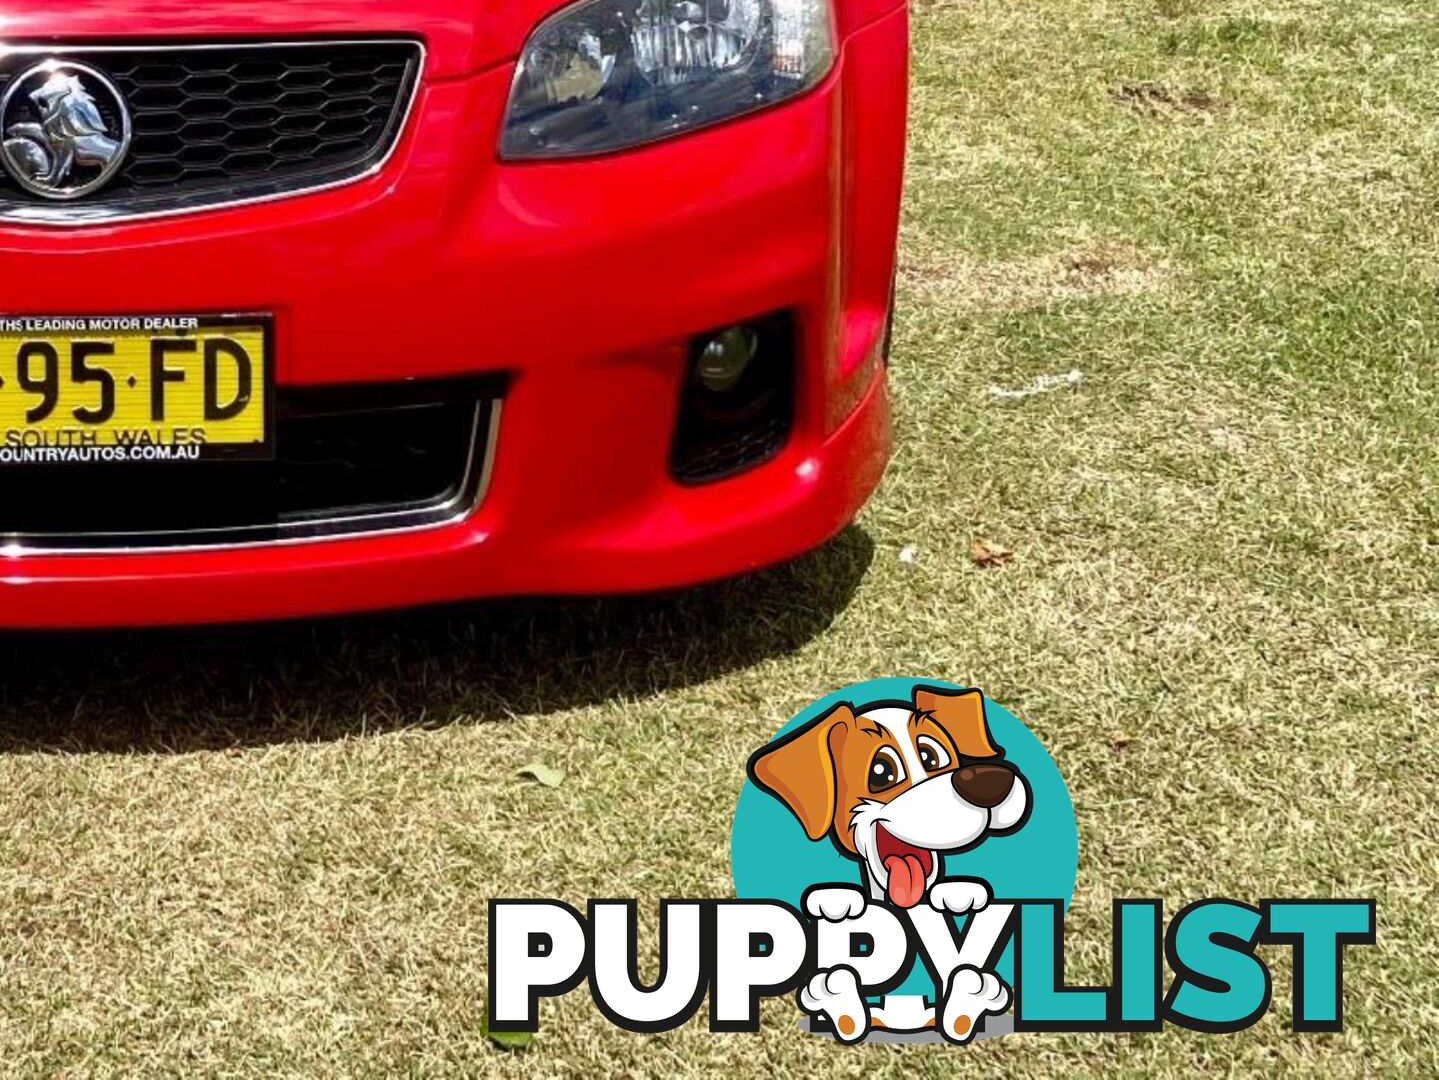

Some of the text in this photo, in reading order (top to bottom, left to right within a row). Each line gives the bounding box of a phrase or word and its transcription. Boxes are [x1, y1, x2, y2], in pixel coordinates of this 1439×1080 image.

[25, 318, 86, 331] LEADING
[89, 318, 140, 331] MOTOR
[144, 317, 199, 329] DEALER
[5, 429, 97, 447] SOUTH
[113, 427, 207, 446] WALES
